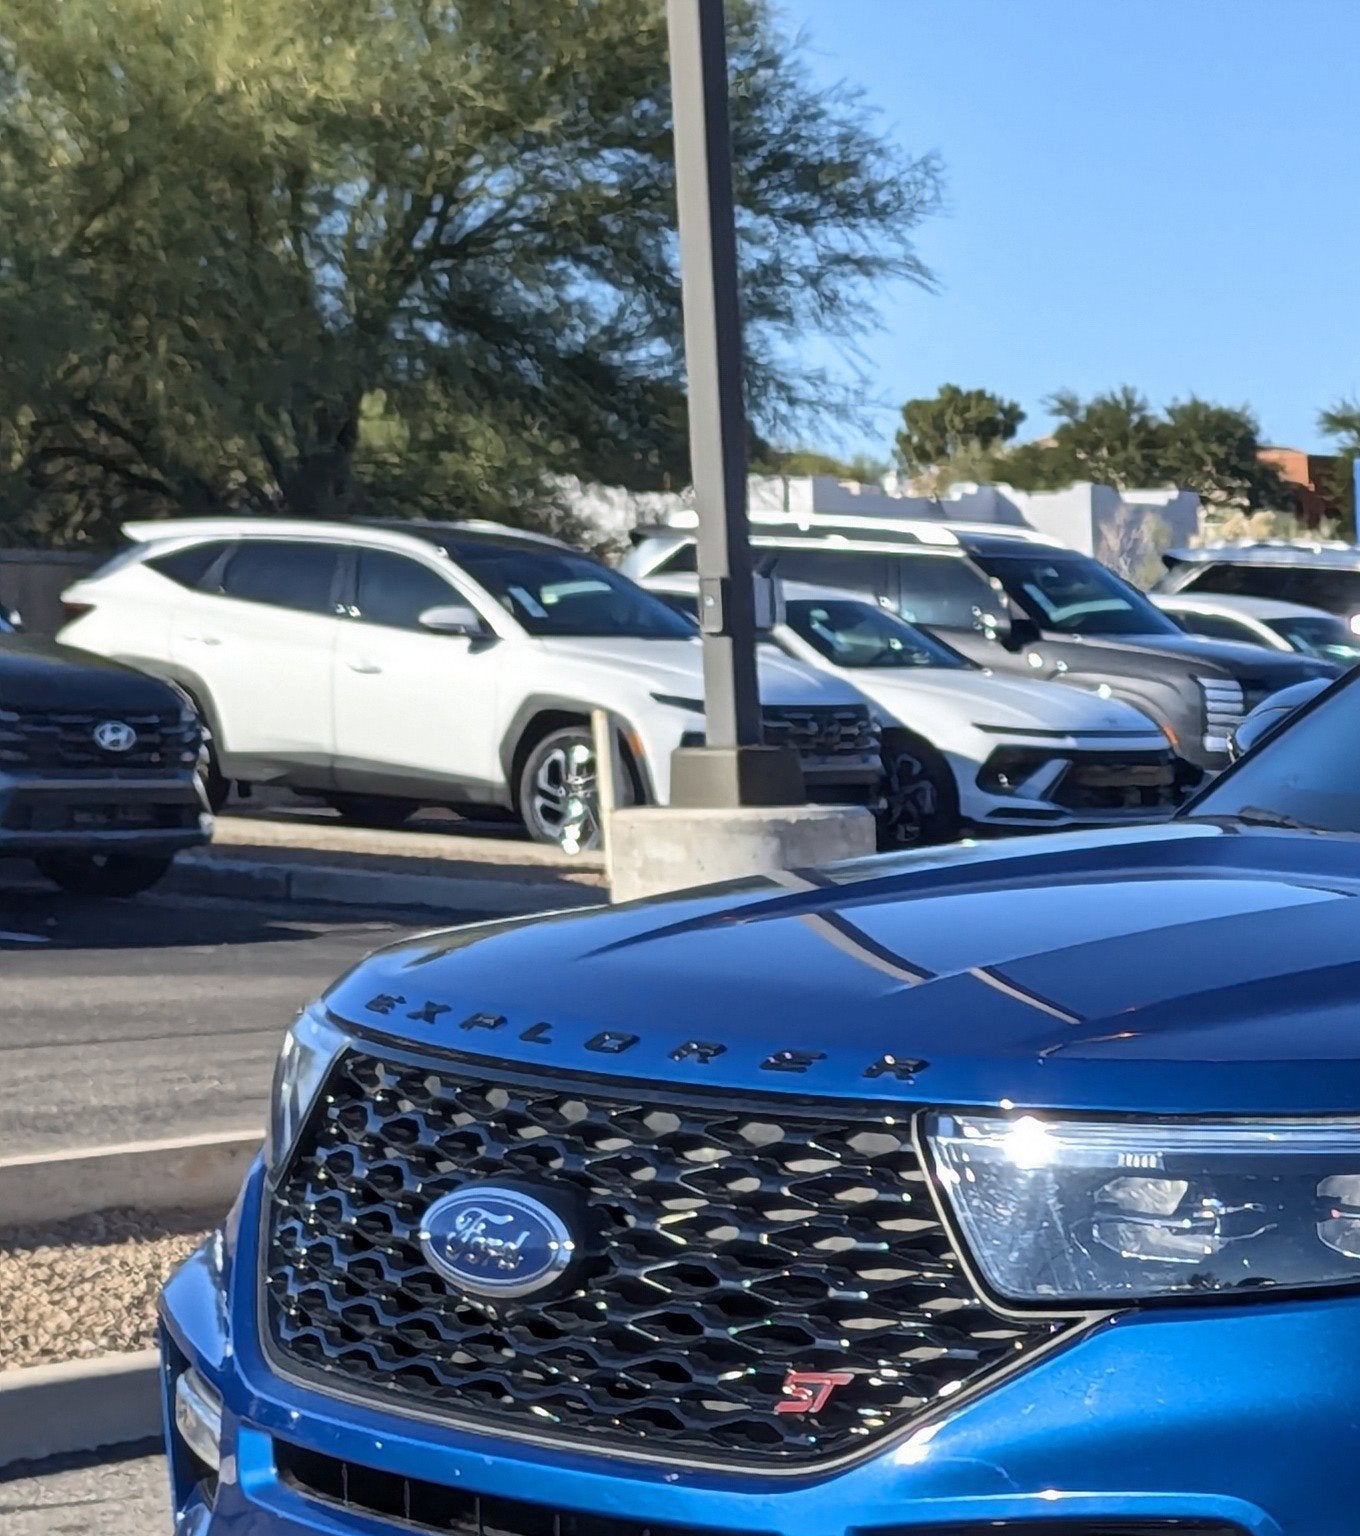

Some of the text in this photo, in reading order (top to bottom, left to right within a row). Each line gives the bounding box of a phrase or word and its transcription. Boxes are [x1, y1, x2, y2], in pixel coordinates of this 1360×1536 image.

[365, 993, 930, 1083] EXPLORER
[445, 1207, 530, 1271] Ford
[773, 1371, 855, 1415] ST
